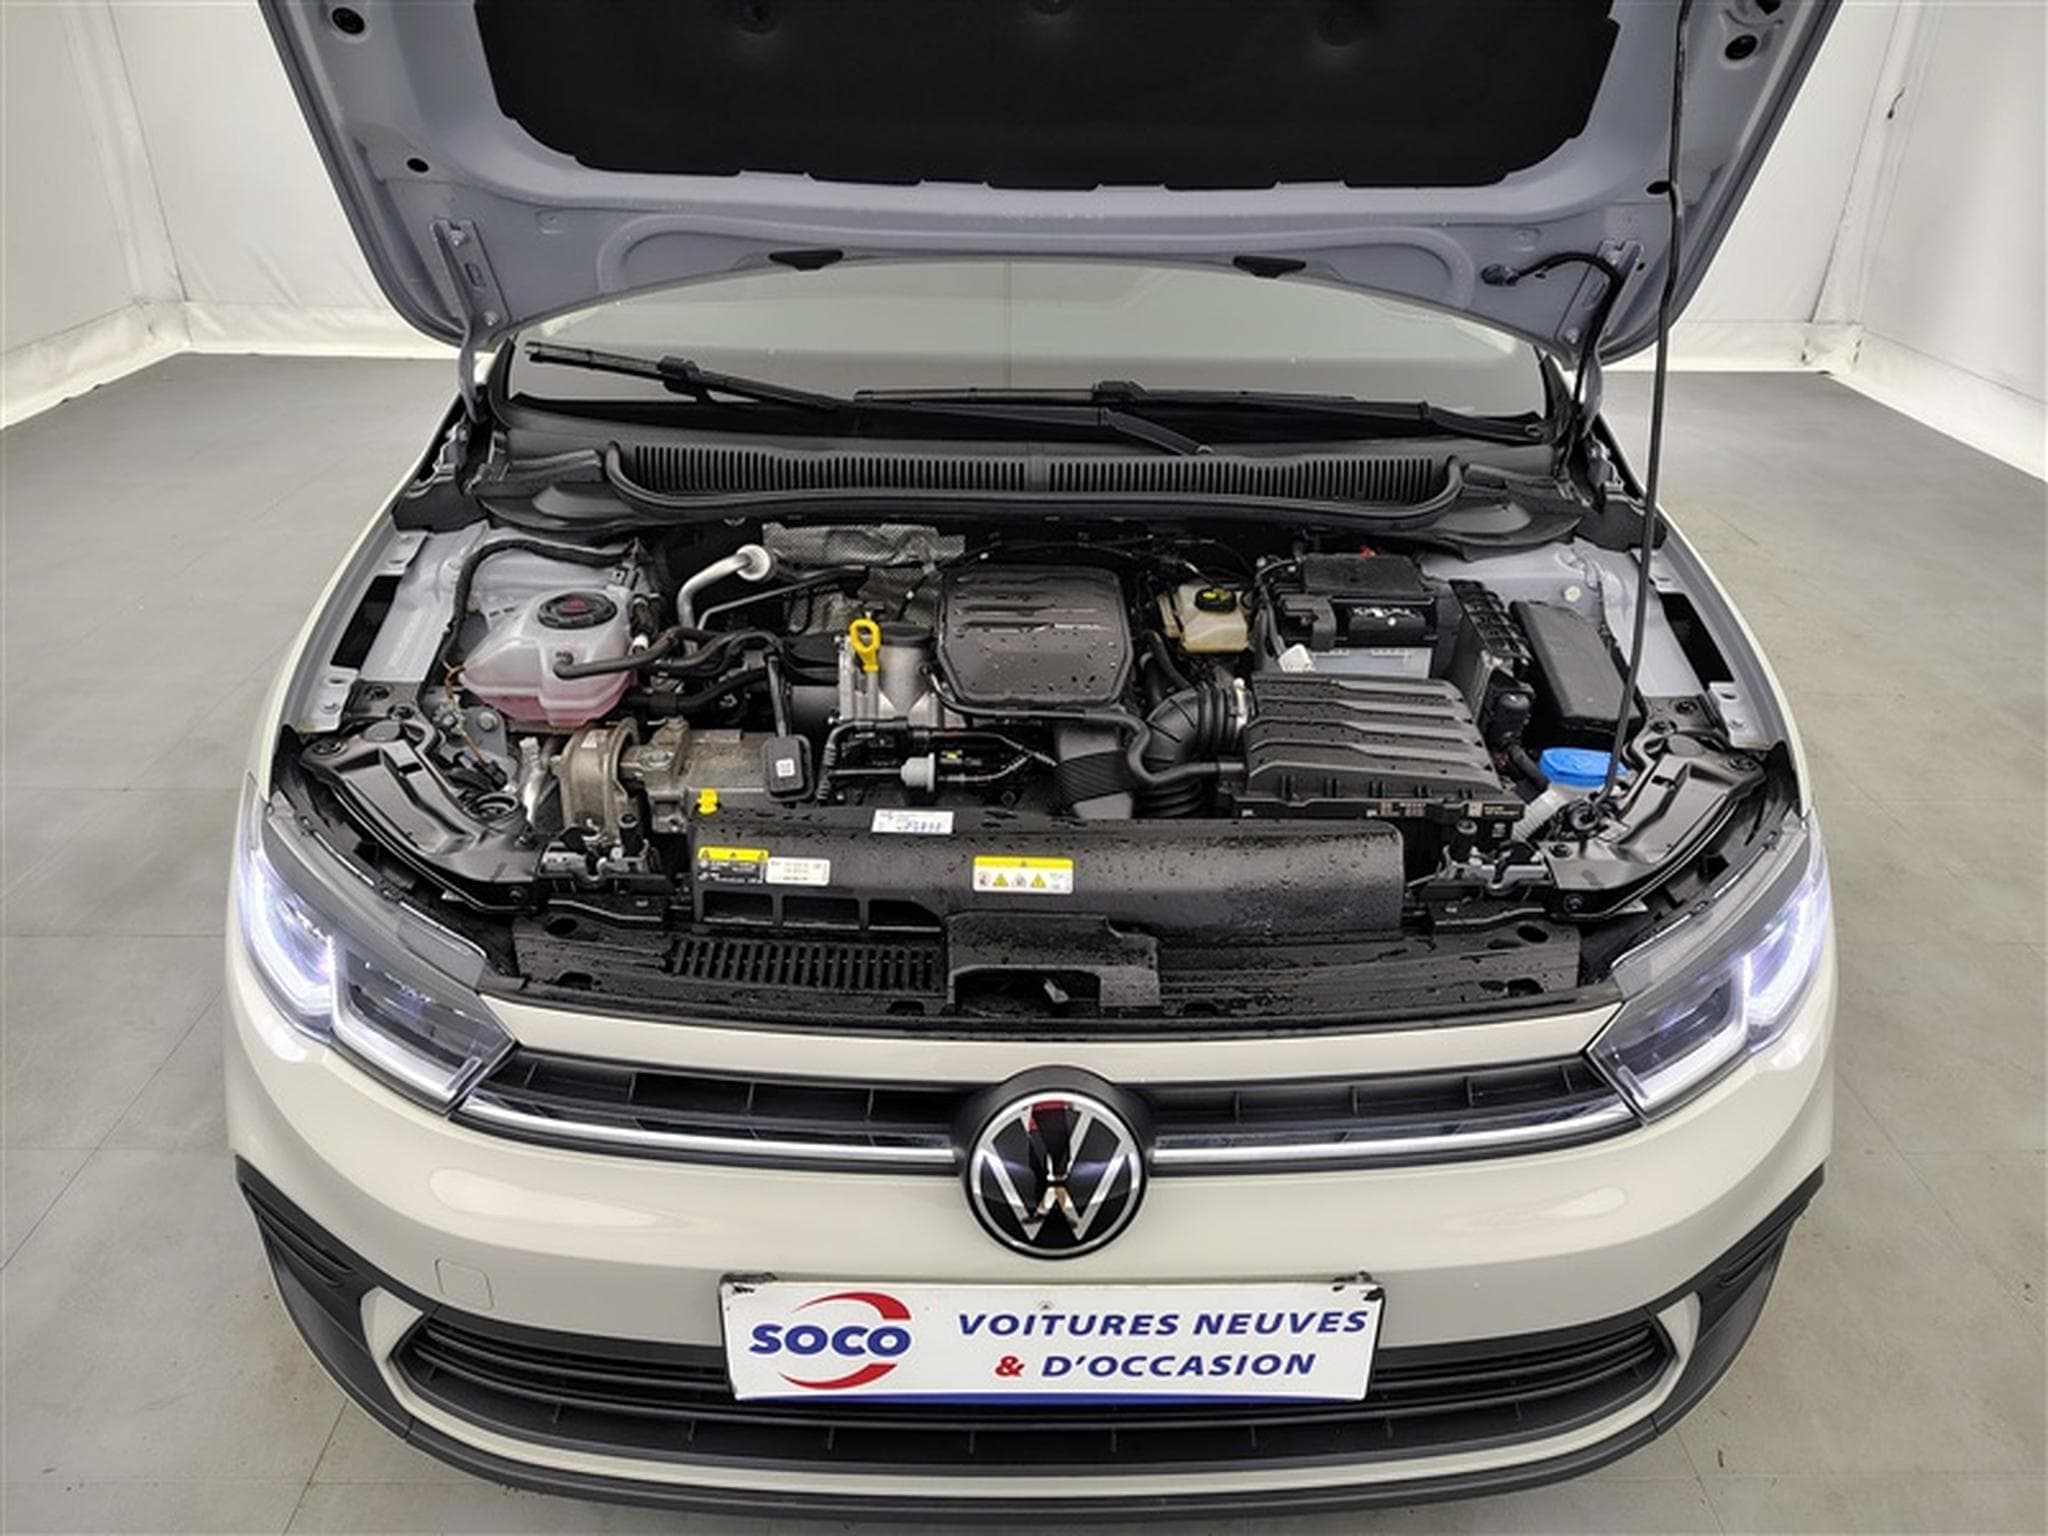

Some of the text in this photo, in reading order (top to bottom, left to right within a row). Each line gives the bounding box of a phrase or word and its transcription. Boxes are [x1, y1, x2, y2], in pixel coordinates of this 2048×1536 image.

[958, 1309, 1369, 1336] VOITURES NEUVES
[749, 1323, 912, 1357] SOCO
[994, 1353, 1316, 1378] & D'OCCASION
